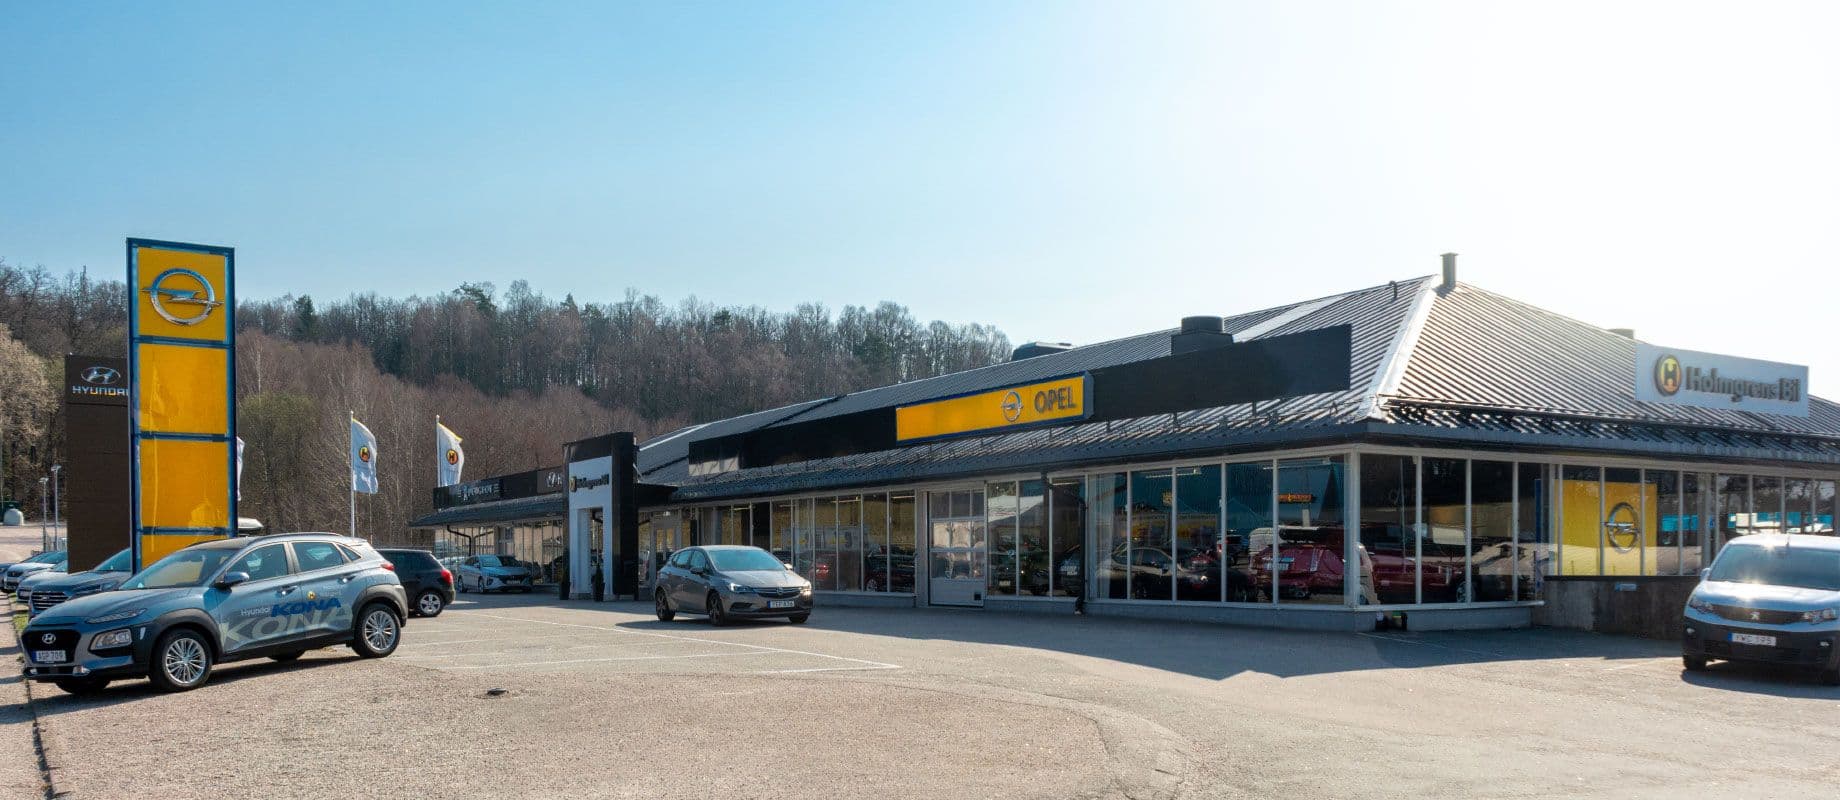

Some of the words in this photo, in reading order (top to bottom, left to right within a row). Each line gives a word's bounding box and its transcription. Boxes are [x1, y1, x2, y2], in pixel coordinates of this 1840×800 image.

[1686, 366, 1776, 402] Holmgrens
[1778, 377, 1800, 402] Bil
[1034, 386, 1077, 414] OPEL
[240, 606, 270, 617] Hyundai
[271, 597, 341, 618] KONA
